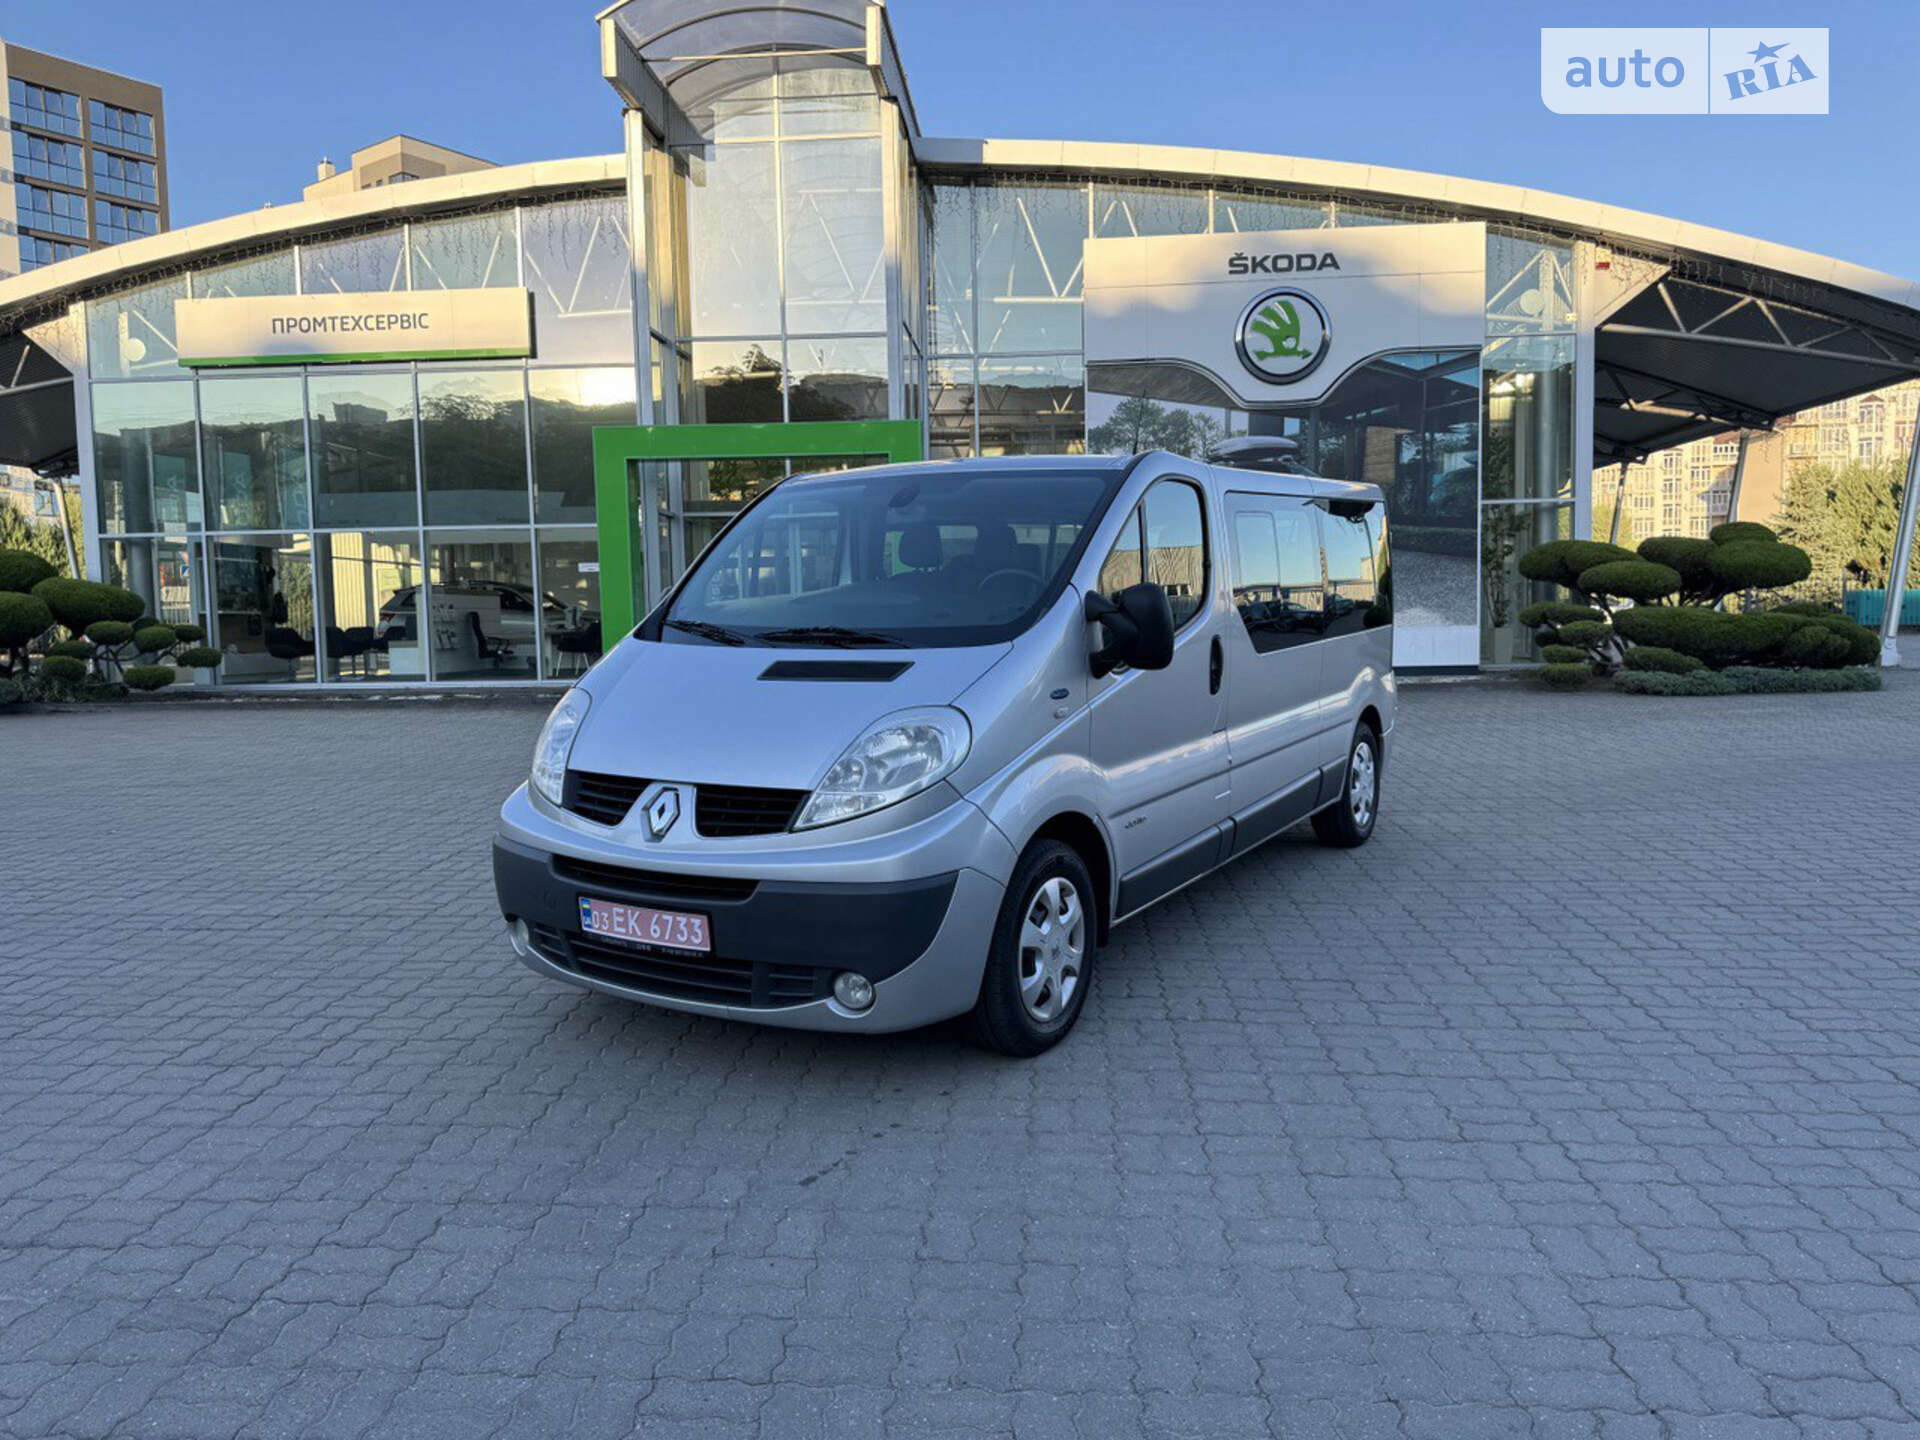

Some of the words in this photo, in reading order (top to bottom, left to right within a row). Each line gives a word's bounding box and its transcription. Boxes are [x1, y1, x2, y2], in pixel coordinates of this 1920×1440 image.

[1228, 252, 1341, 275] ŠKODA
[272, 312, 430, 335] ПРОМТЕХСЕРВІС
[591, 910, 610, 931] 03
[612, 907, 643, 937] EK
[650, 913, 703, 945] 6733
